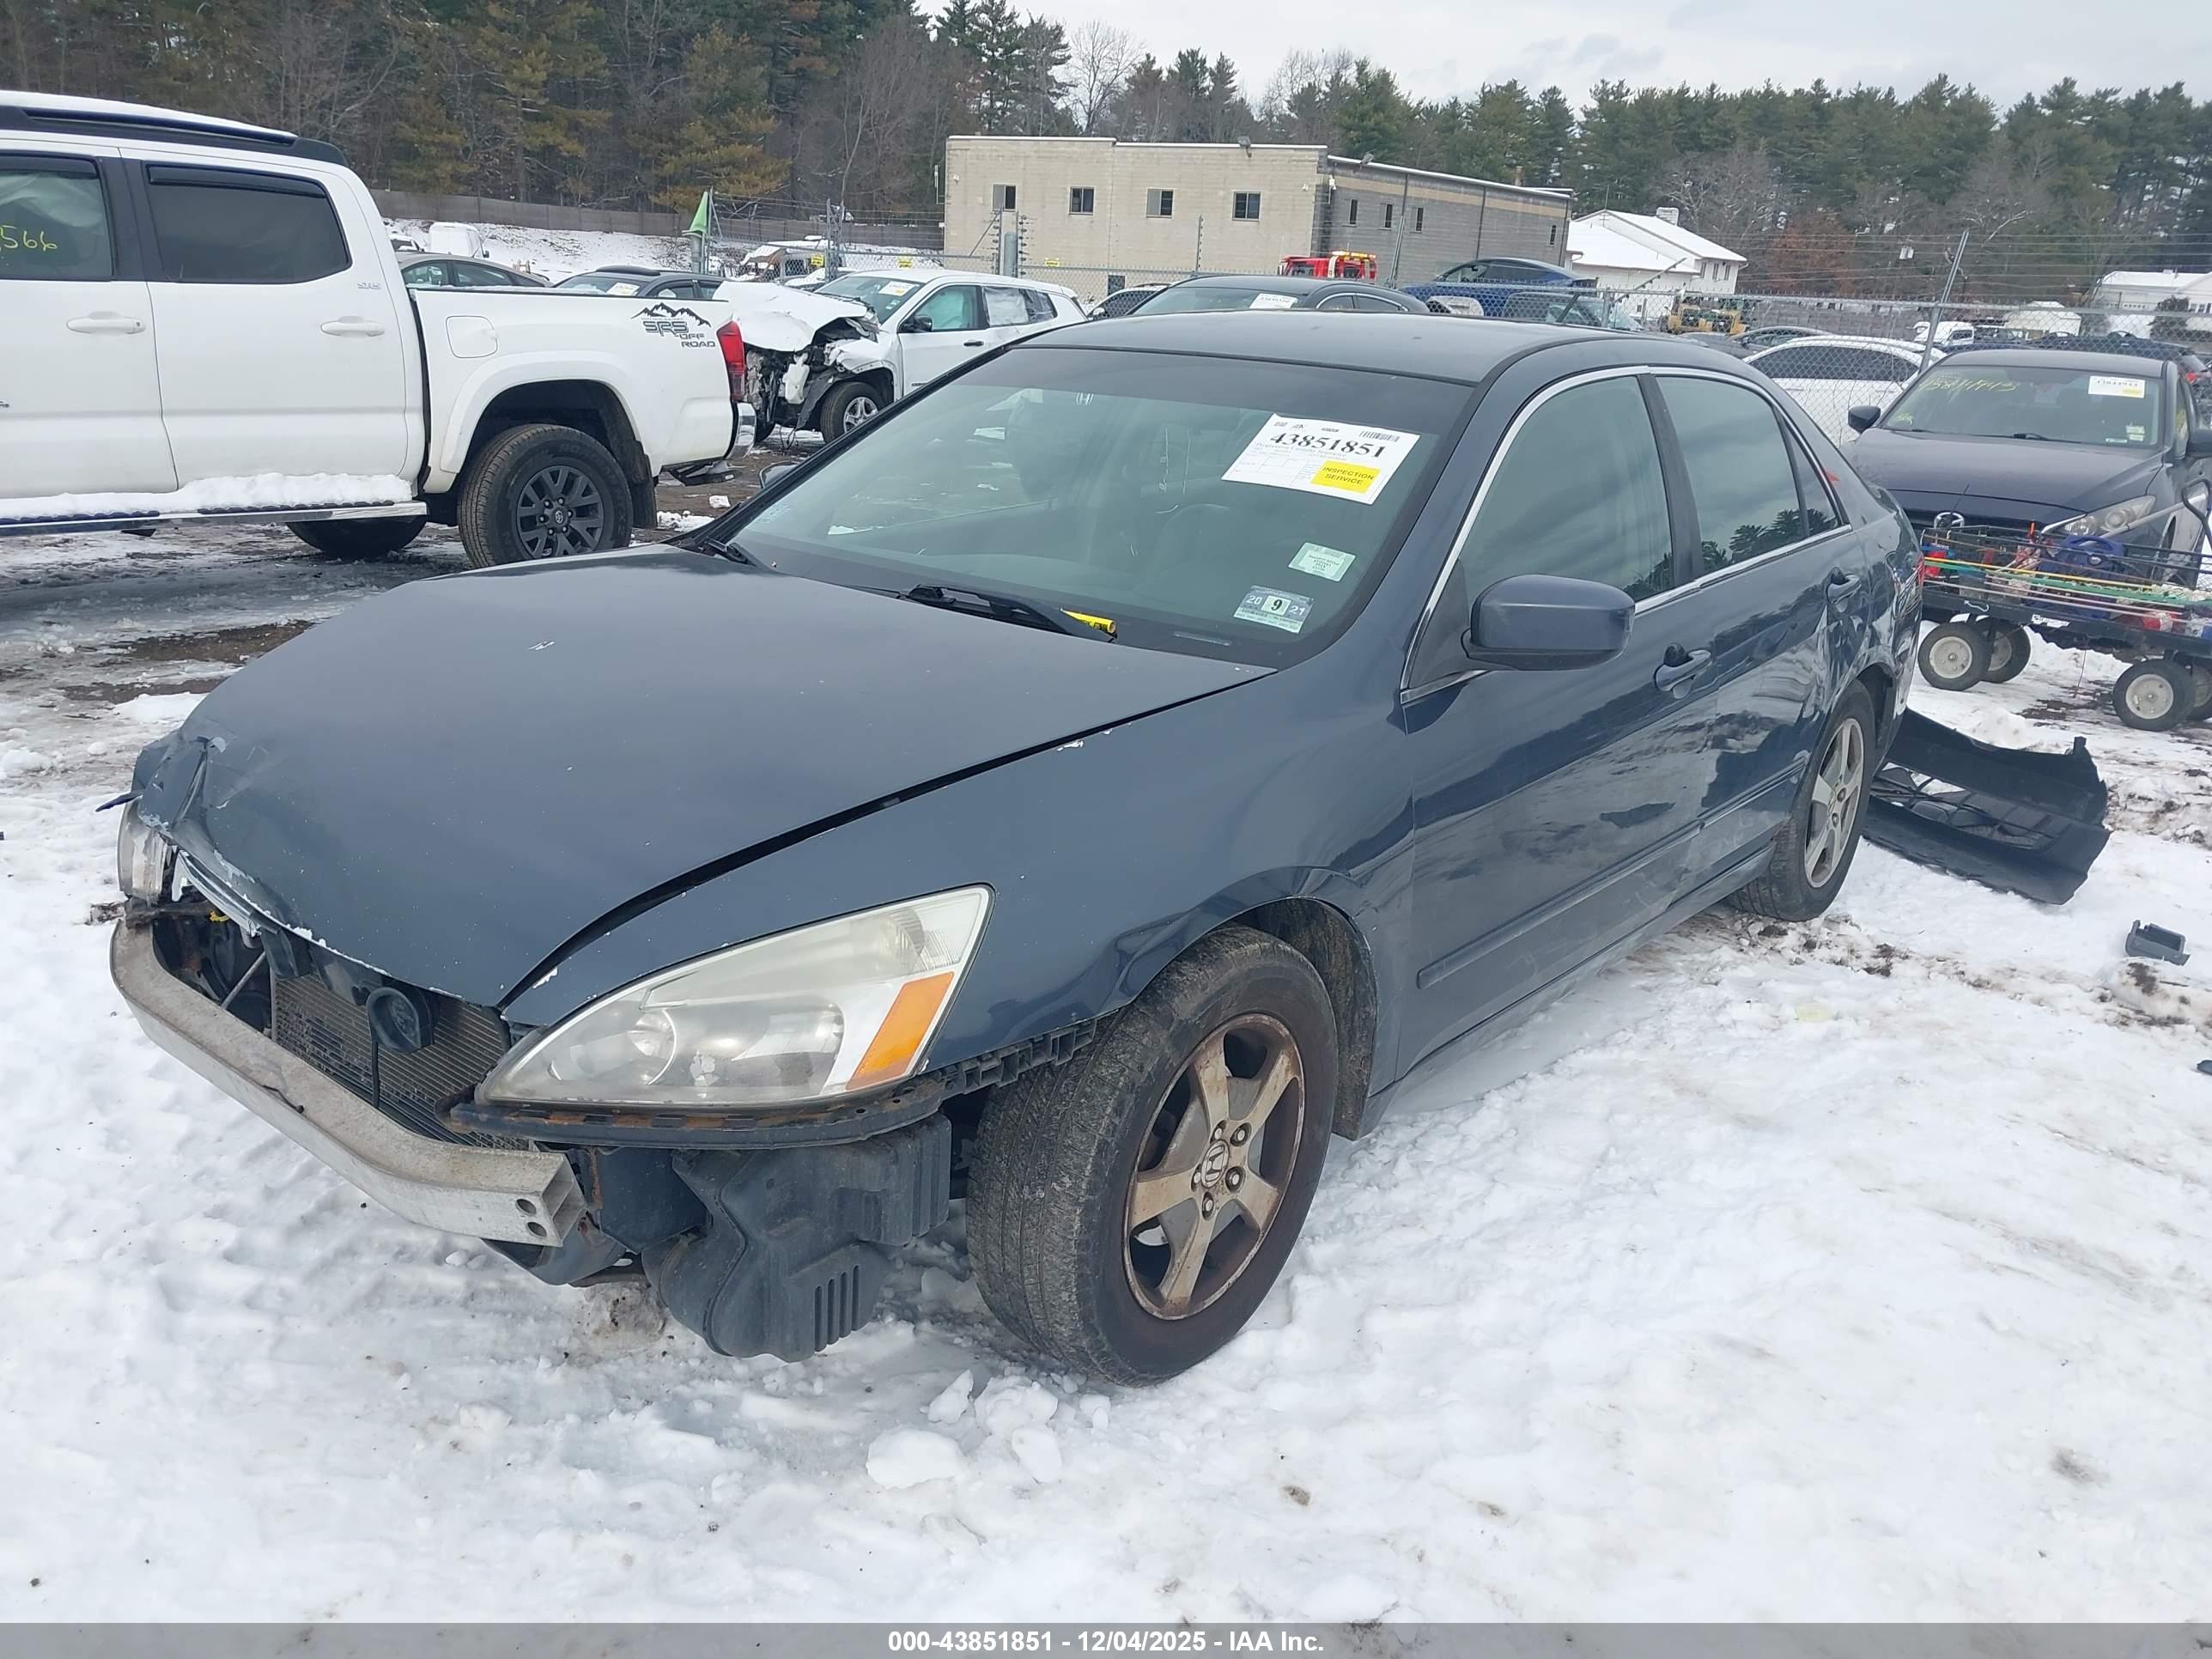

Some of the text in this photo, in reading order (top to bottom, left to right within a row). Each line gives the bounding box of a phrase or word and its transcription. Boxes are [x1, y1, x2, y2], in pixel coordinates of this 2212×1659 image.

[1270, 432, 1386, 459] 43851851
[1322, 466, 1375, 481] INSPECTION
[1324, 473, 1364, 485] SERVICE
[1246, 594, 1263, 605] 20
[1271, 599, 1283, 611] 9
[1289, 605, 1306, 617] 21
